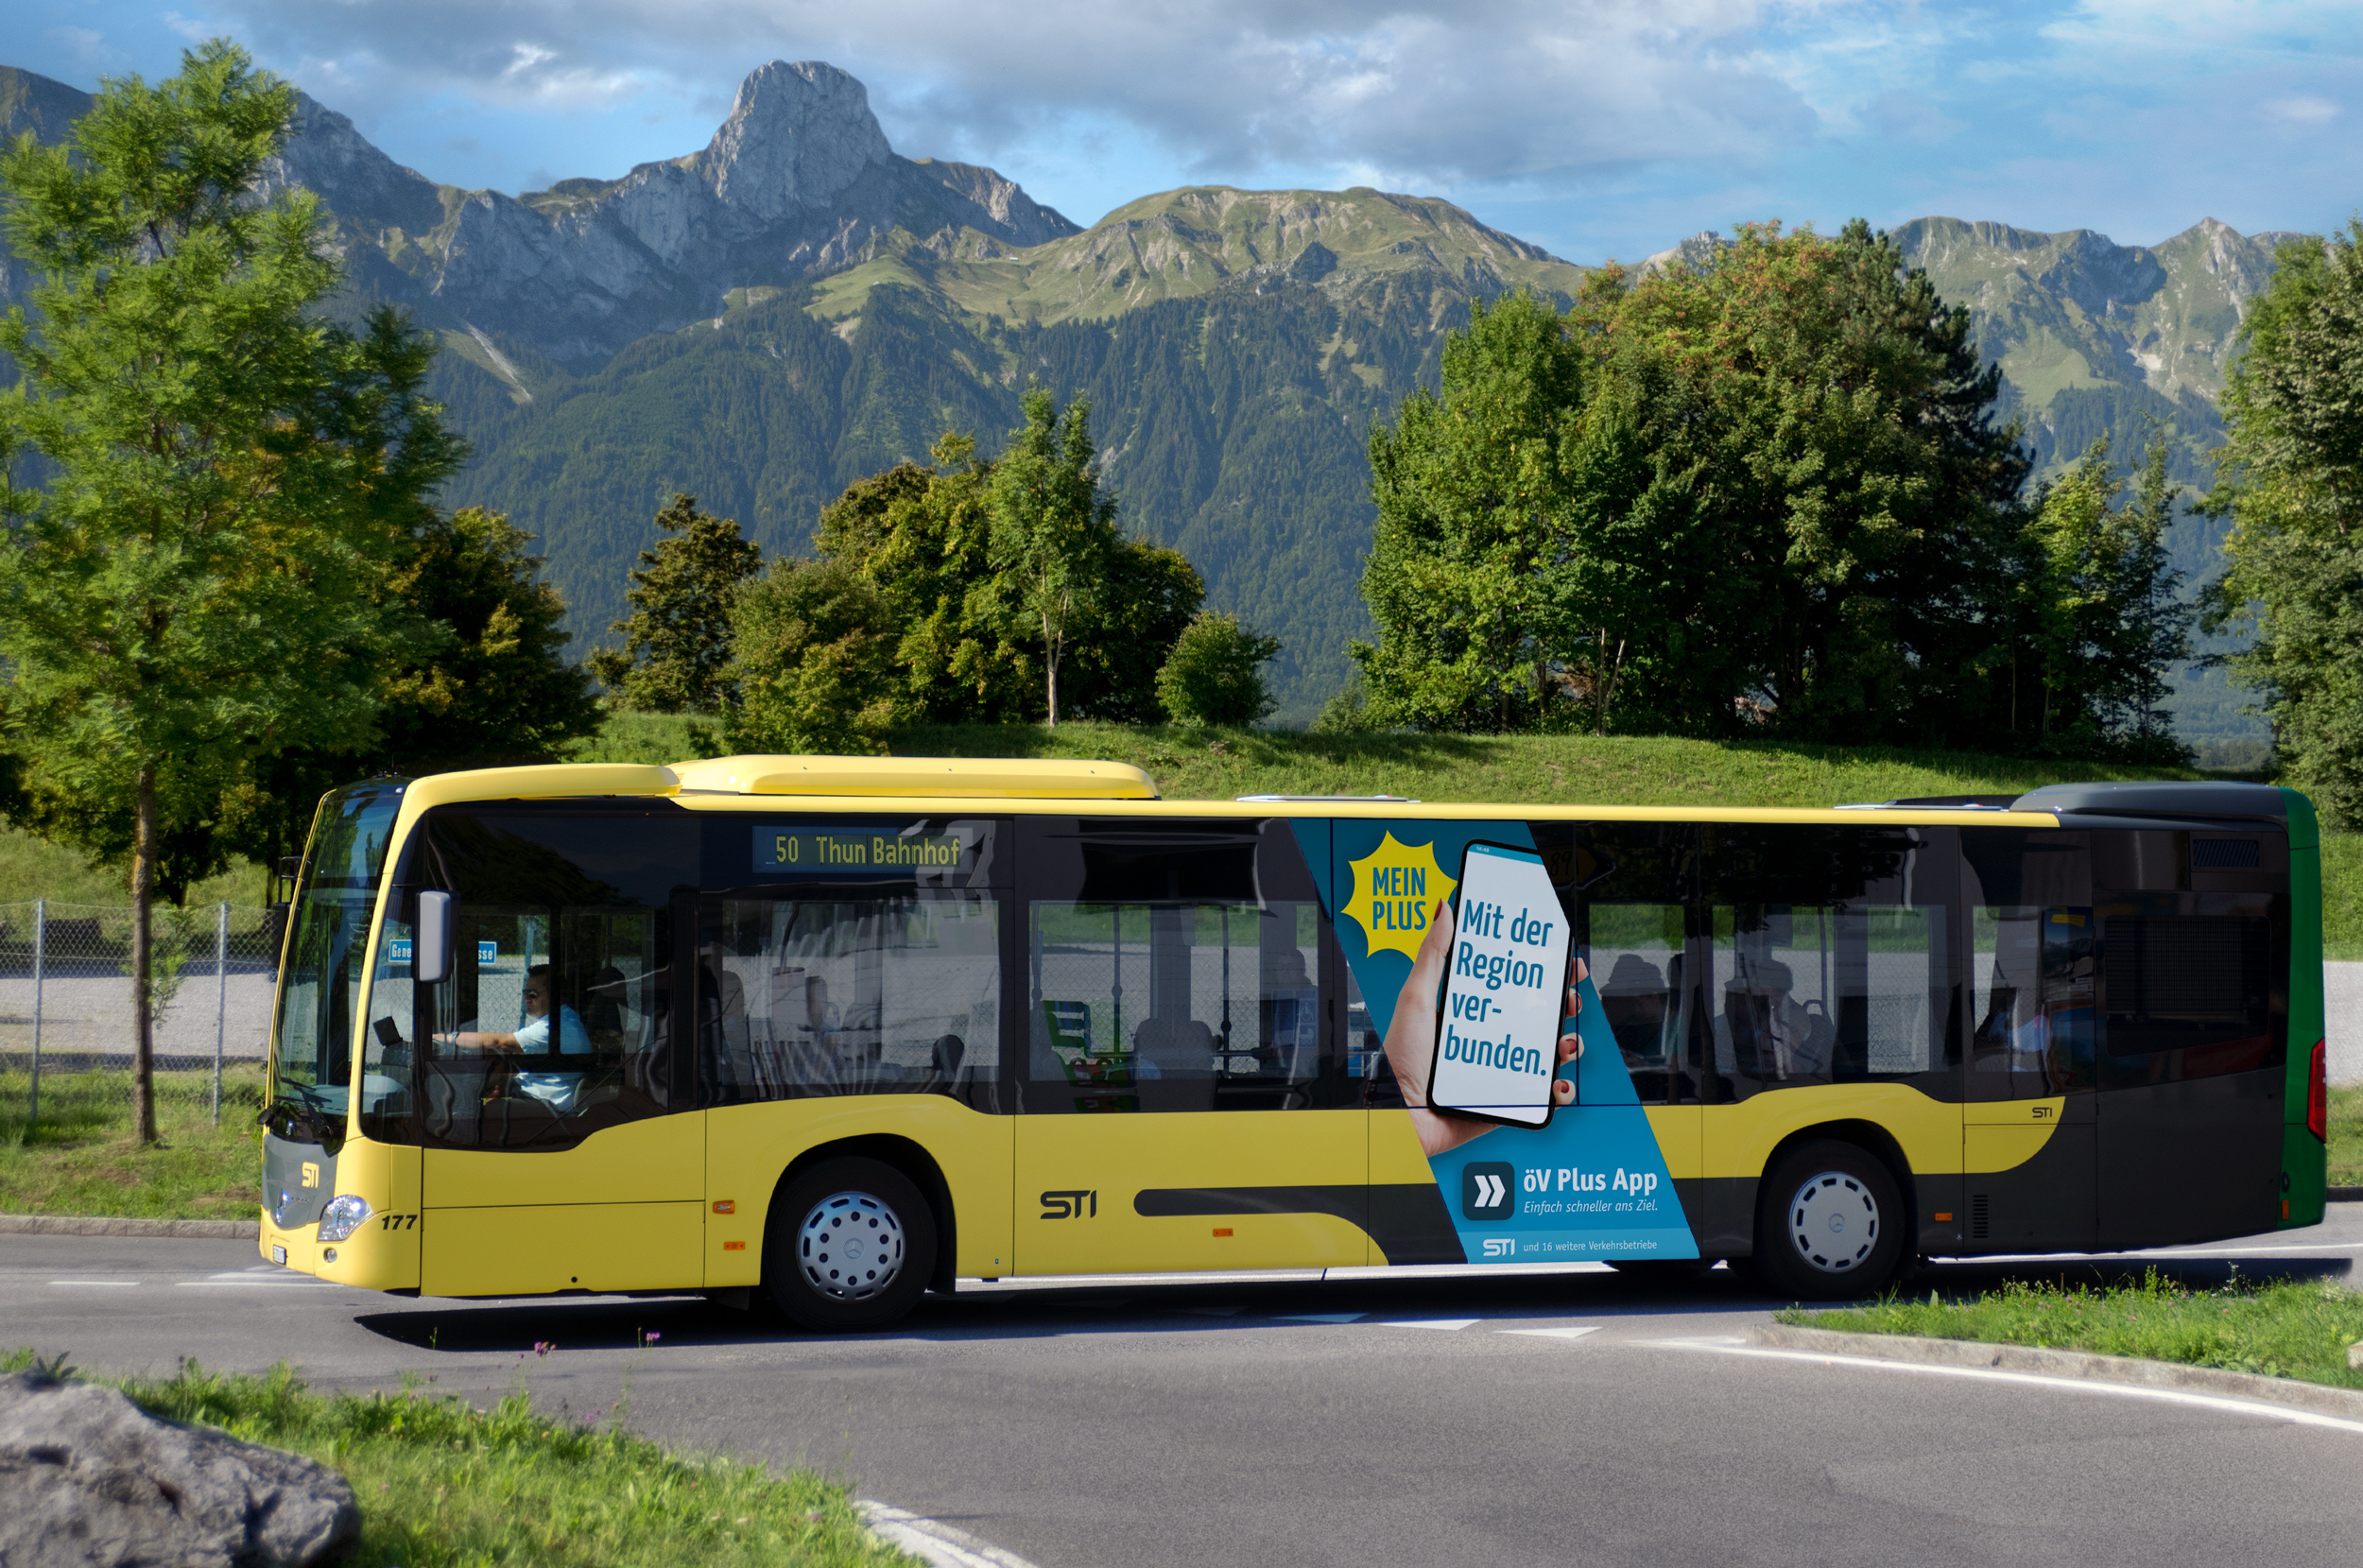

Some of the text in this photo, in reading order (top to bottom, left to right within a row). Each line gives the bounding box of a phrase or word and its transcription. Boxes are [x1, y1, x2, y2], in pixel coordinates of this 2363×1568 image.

[776, 836, 960, 865] 50 Thun Bahnhof
[1372, 867, 1425, 896] MEIN
[1372, 901, 1426, 930] PLUS
[1461, 899, 1553, 947] Mit der
[1456, 940, 1544, 991] Region
[1452, 992, 1502, 1023] ver-
[1443, 1024, 1546, 1077] bunden.
[2032, 1107, 2053, 1118] STI
[302, 1162, 319, 1188] STI
[1523, 1167, 1658, 1197] öV Plus App
[1040, 1190, 1097, 1219] STI
[1524, 1198, 1659, 1216] Einfach schneller ans Ziel.
[381, 1215, 418, 1231] 177
[1482, 1238, 1658, 1257] STI und 16 weitere Verkehrsbetriebe
